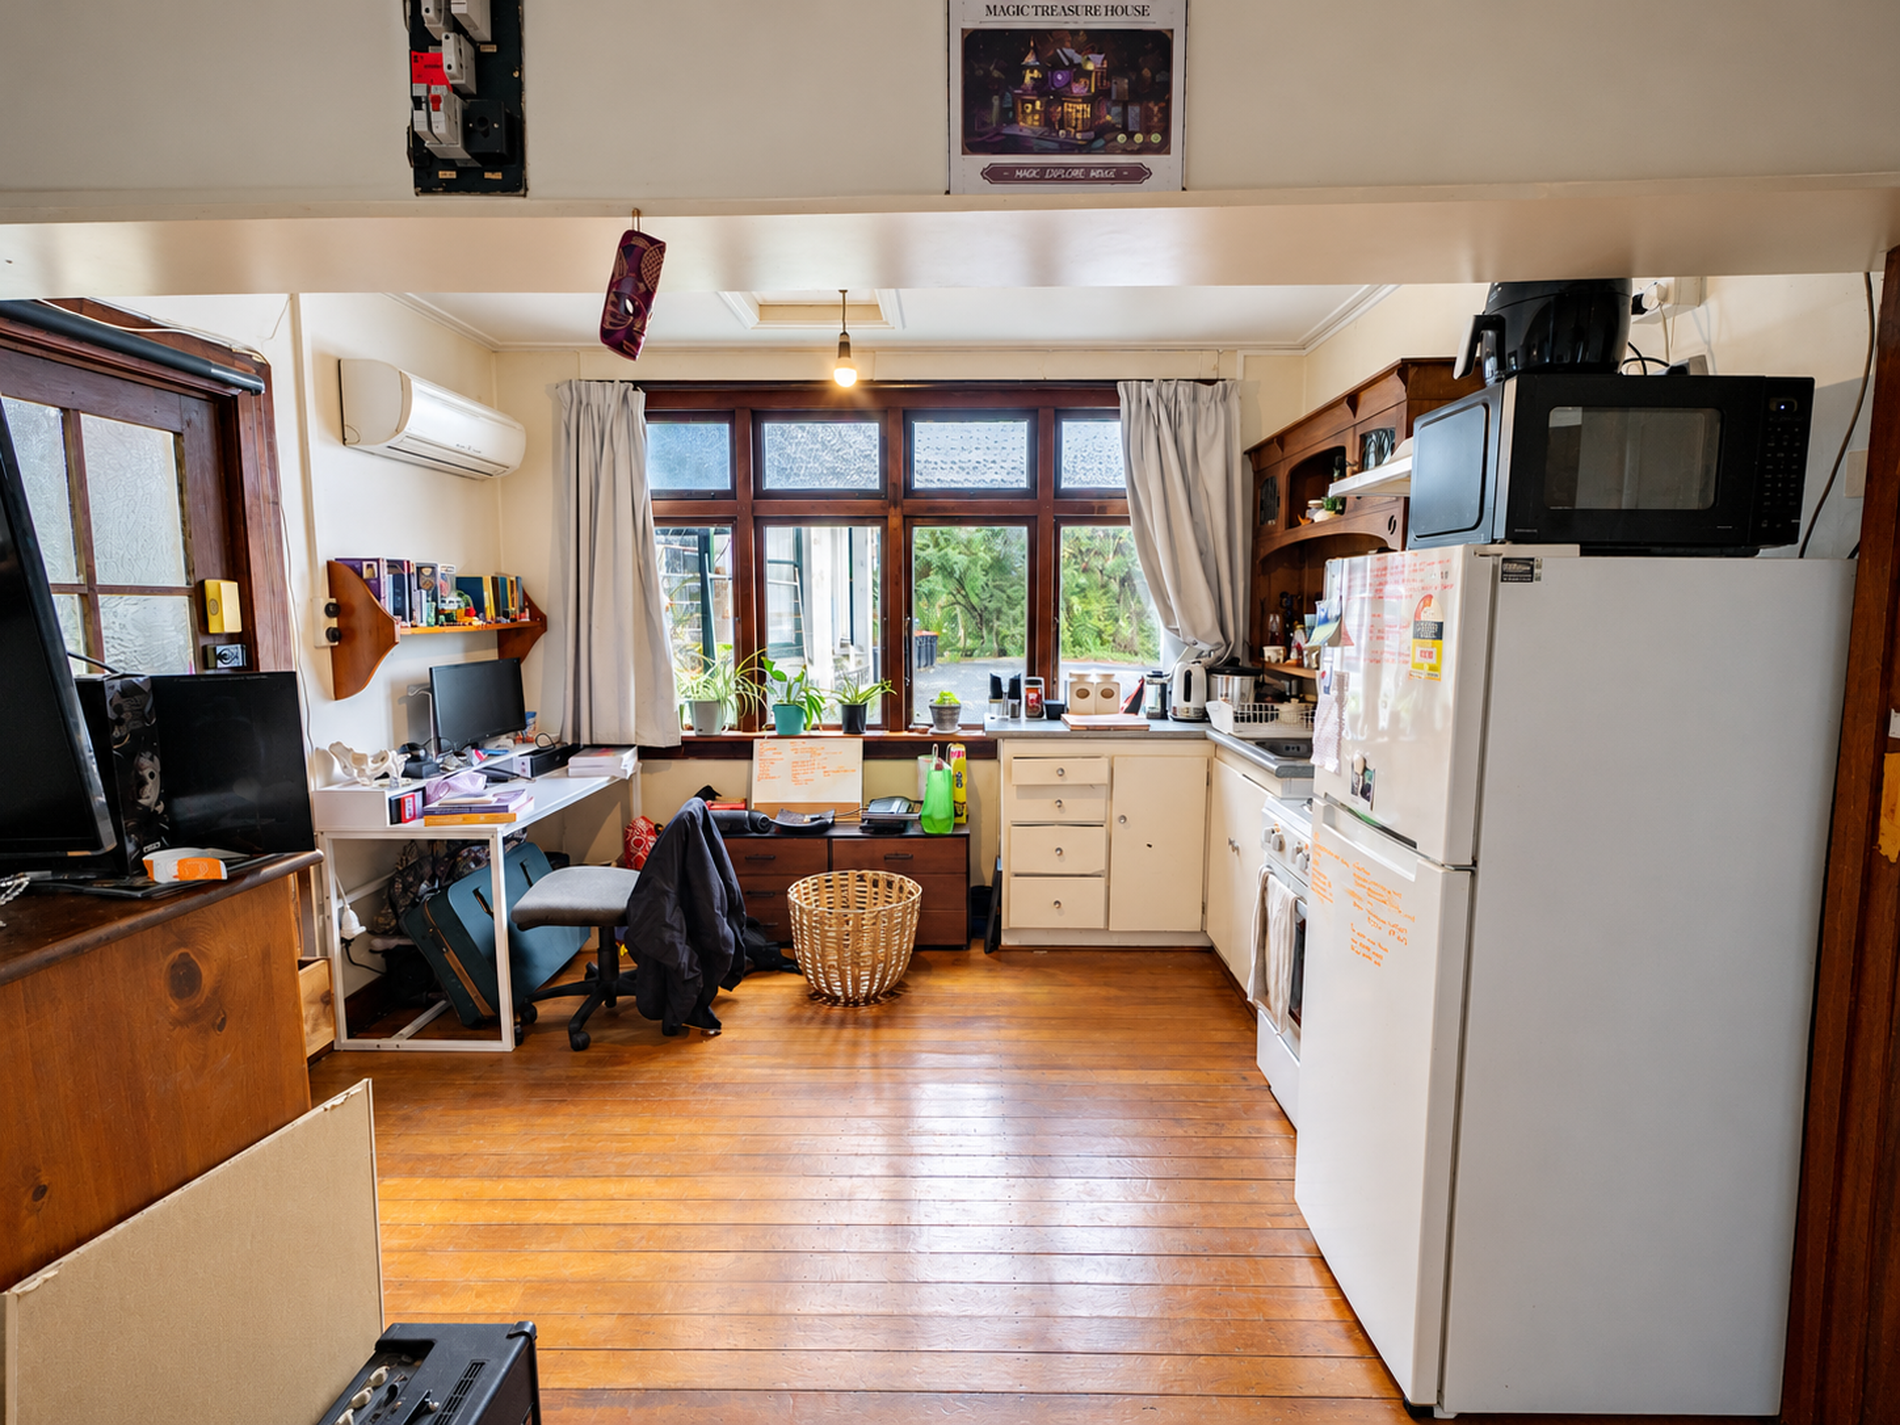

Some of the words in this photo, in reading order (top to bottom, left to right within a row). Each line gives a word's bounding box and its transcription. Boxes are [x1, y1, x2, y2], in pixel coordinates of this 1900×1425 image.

[985, 4, 1030, 17] MAGIC
[1031, 4, 1102, 17] TREASURE
[1104, 4, 1150, 17] HOUSE
[1014, 168, 1040, 178] MAGIC
